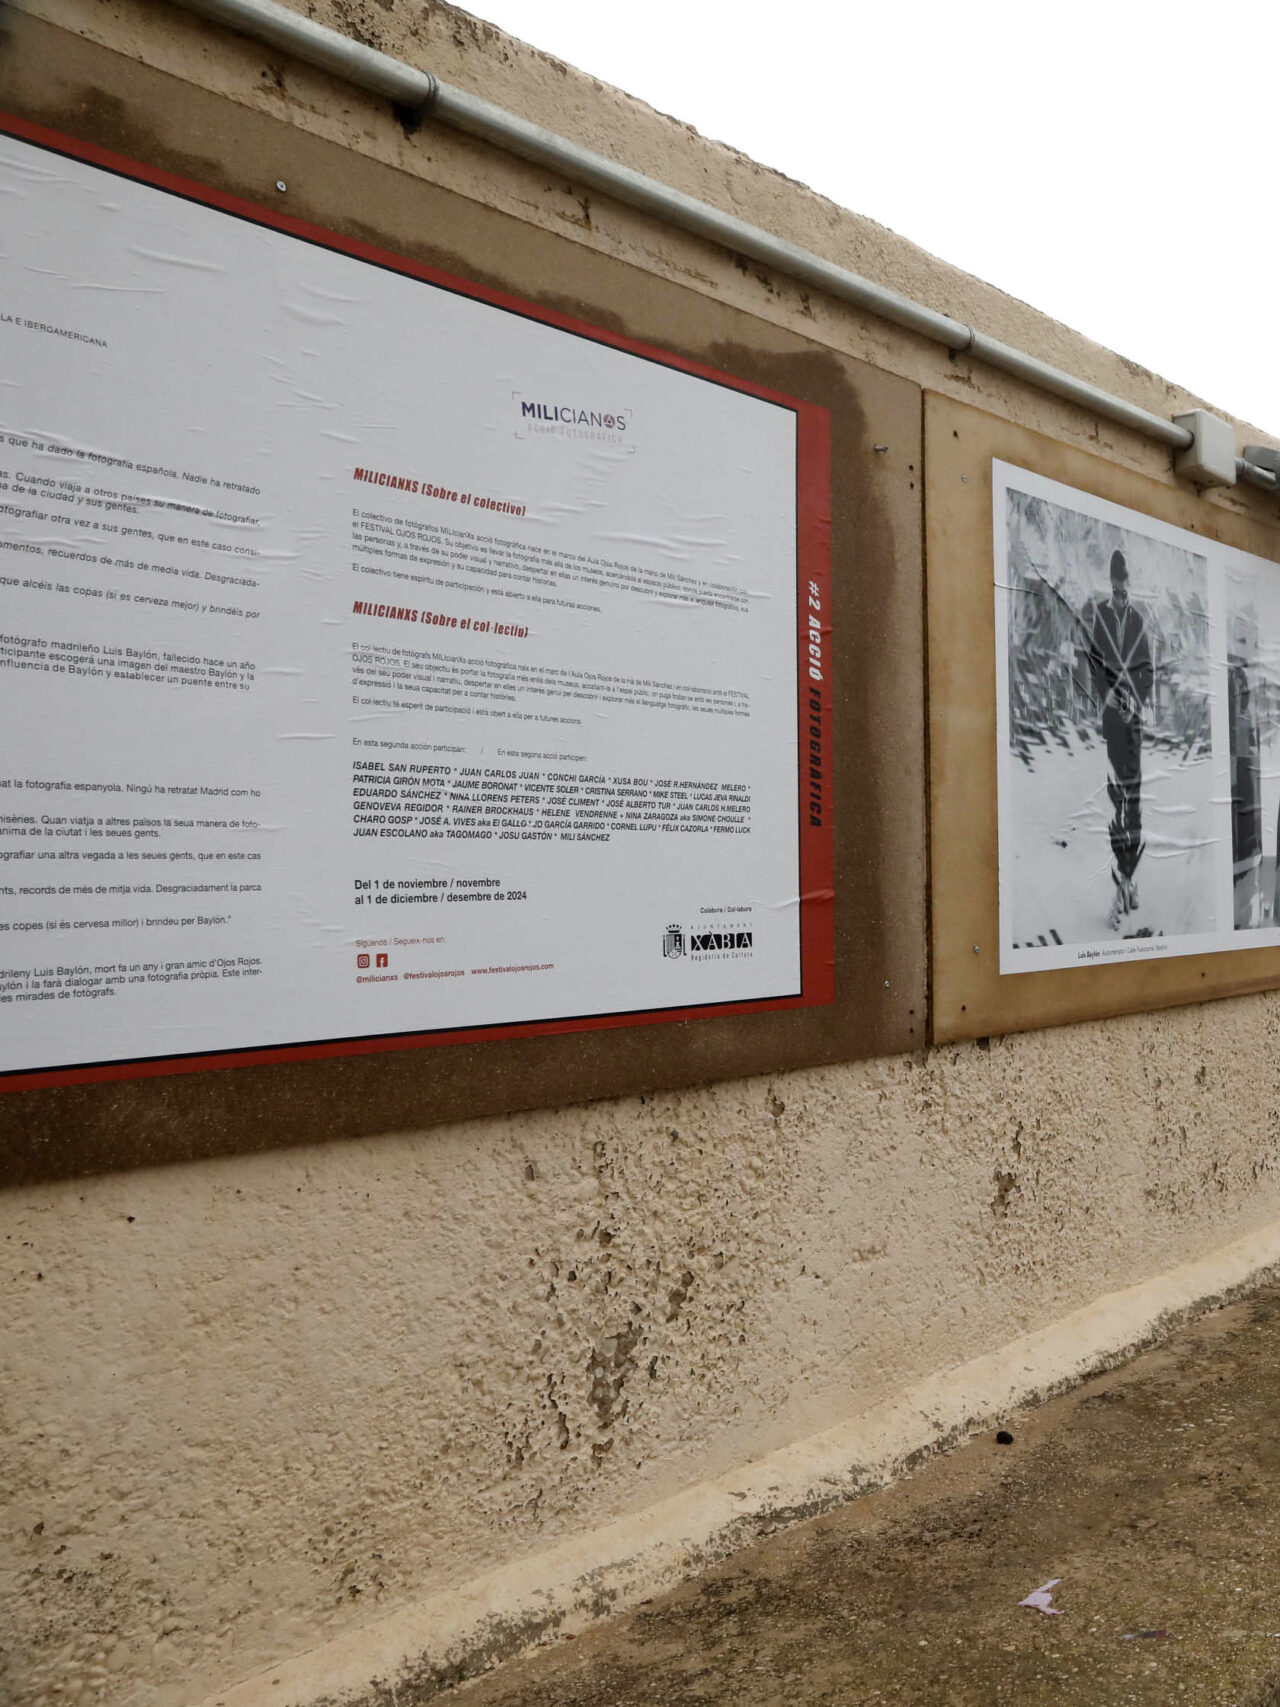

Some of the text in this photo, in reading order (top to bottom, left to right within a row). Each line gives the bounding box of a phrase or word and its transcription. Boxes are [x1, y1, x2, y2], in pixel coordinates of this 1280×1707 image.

[0, 313, 108, 348] LA E IBEROAMERICANA
[353, 467, 526, 516] MILICIANXS (Sobre el colectivo)
[0, 576, 260, 619] que alcéis las copas (si es cerveza mejor) y brindéis por
[808, 580, 821, 610] #2
[352, 600, 419, 622] MILICIANXS
[460, 618, 471, 630] el
[808, 614, 824, 680] ACCIÓ
[352, 760, 385, 771] ISABEL
[388, 762, 407, 772] SAN
[409, 764, 451, 775] RUPERTO
[459, 767, 482, 776] JUAN
[484, 768, 516, 779] CARLOS
[518, 771, 539, 780] JUAN
[547, 772, 577, 782] CONCHI
[578, 774, 606, 784] GARCÍA
[612, 777, 631, 785] XUSA
[632, 778, 648, 786] BOU
[654, 779, 672, 788] JOSÉ
[720, 783, 746, 792] MELERO
[13, 779, 23, 788] la
[24, 779, 72, 791] fotografia
[74, 783, 123, 793] espanyola.
[154, 785, 166, 794] ha
[167, 786, 198, 795] retratat
[200, 786, 229, 796] Madrid
[230, 789, 248, 797] com
[250, 788, 261, 797] ho
[352, 774, 391, 784] PATRICIA
[392, 776, 420, 786] GIRÓN
[422, 778, 445, 787] MOTA
[451, 779, 480, 789] JAUME
[480, 780, 518, 791] BORONAT
[524, 783, 555, 793] VICENTE
[555, 784, 579, 794] SOLER
[584, 786, 615, 796] CRISTINA
[616, 788, 648, 798] SERRANO
[652, 790, 669, 798] MIKE
[669, 791, 688, 800] STEEL
[693, 792, 713, 801] LUCAS
[728, 794, 751, 802] RINALDI
[352, 787, 398, 798] EDUARDO
[400, 788, 442, 800] SÁNCHEZ
[449, 792, 470, 801] NINA
[471, 793, 508, 803] LLORENS
[510, 794, 540, 804] PETERS
[546, 796, 566, 805] JOSÉ
[568, 797, 600, 806] CLIMENT
[605, 798, 624, 808] JOSÉ
[625, 800, 656, 809] ALBERTO
[657, 801, 671, 810] TUR
[676, 802, 694, 810] JUAN
[694, 803, 719, 812] CARLOS
[353, 800, 401, 811] GENOVEVA
[404, 802, 443, 812] REGIDOR
[451, 804, 482, 814] RAINER
[484, 806, 534, 816] BROCKHAUS
[625, 811, 642, 820] NINA
[642, 812, 678, 821] ZARAGOZA
[691, 814, 716, 822] SIMONE
[352, 814, 386, 824] CHARO
[387, 815, 413, 824] GOSP
[418, 815, 442, 825] JOSÉ
[453, 817, 476, 826] VIVES
[476, 818, 491, 826] aka
[501, 818, 527, 828] GALLO
[544, 819, 572, 829] GARCÍA
[572, 821, 605, 830] GARRIDO
[610, 822, 638, 831] CORNEL
[661, 822, 679, 832] FÉLIX
[679, 824, 708, 832] CAZORLA
[713, 825, 734, 834] FERMO
[352, 828, 610, 842] JUAN ESCOLANO aka TAGOMAGO JOSU GASTÓN MILI SÁNCHEZ
[354, 879, 371, 890] Del
[374, 879, 379, 889] 1
[382, 879, 395, 889] de
[397, 878, 448, 888] noviembre
[456, 877, 500, 888] novembre
[354, 894, 364, 905] al
[366, 894, 371, 904] 1
[374, 894, 388, 904] de
[390, 892, 438, 904] diciembre
[446, 891, 492, 902] desembre
[493, 891, 505, 901] de
[506, 890, 527, 900] 2024
[690, 932, 752, 951] XÀBIA
[33, 957, 262, 978] Luis Baylón, mort fa un any i gran amic d'Ojos Rojos.
[356, 963, 554, 983] @milicianxs @festivalojosrojos www.festivalojosrojos.com
